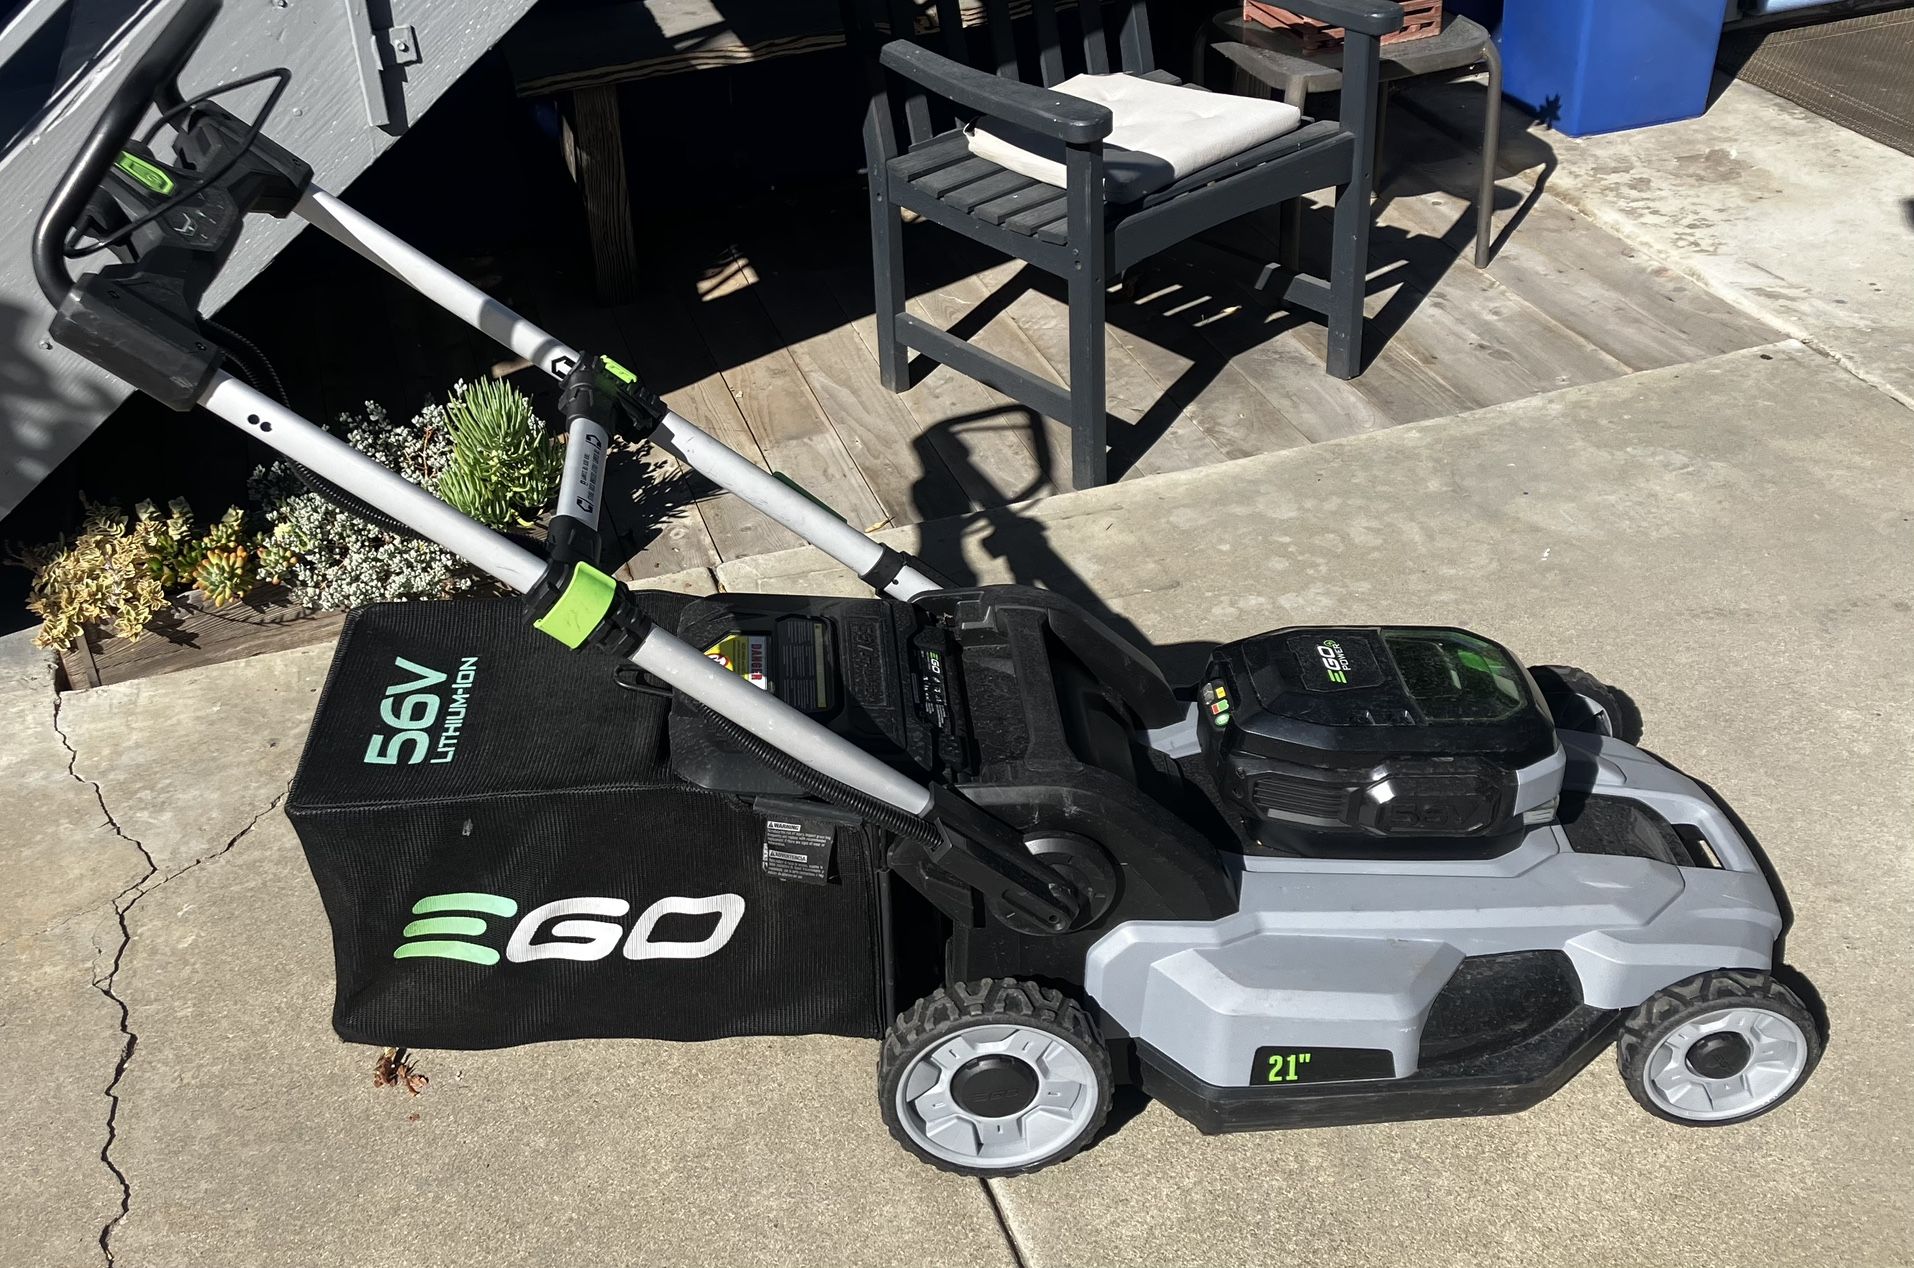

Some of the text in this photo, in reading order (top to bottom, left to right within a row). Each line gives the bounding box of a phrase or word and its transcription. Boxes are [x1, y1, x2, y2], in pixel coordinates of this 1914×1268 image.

[750, 643, 763, 681] DANGER
[929, 650, 941, 674] EGO
[1316, 645, 1347, 684] EGO
[363, 656, 448, 765] 56V
[430, 656, 479, 764] LITHIUM-ION
[393, 892, 746, 966] EGO
[1268, 1053, 1311, 1082] 21"
